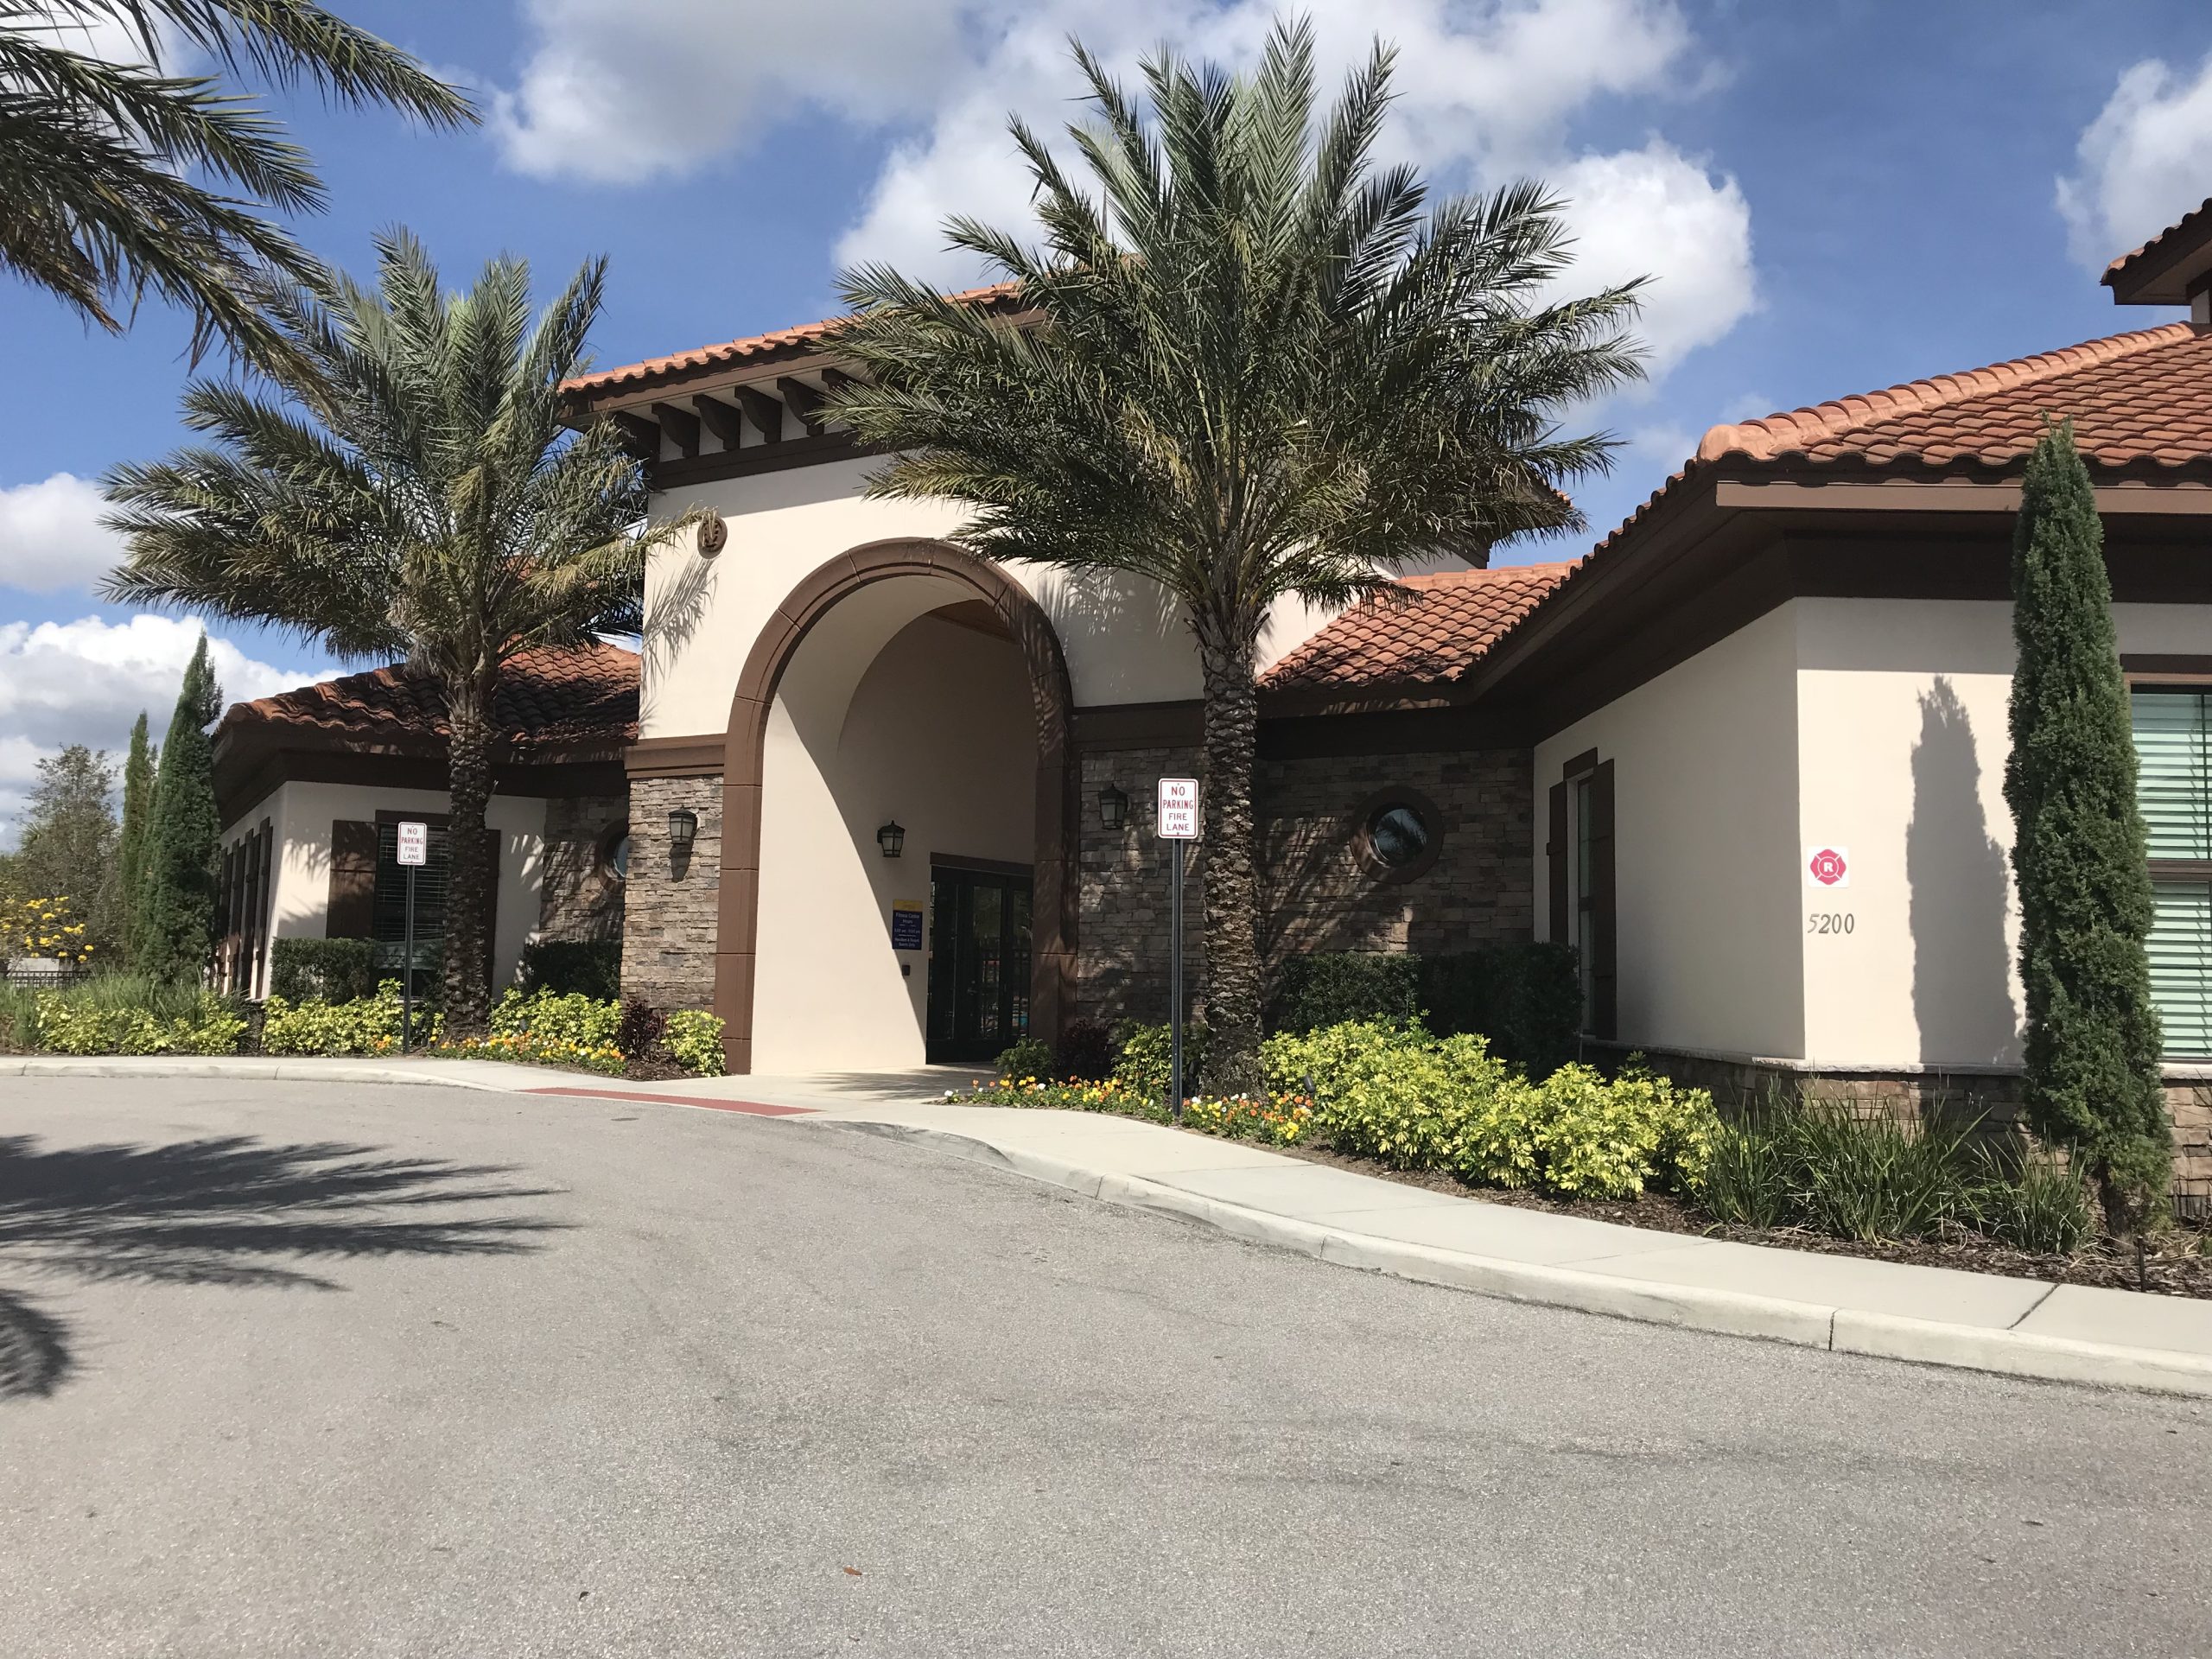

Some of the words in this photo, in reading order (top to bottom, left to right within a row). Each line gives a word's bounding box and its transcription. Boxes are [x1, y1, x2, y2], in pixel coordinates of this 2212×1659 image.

[1171, 785, 1185, 796] NO
[1162, 799, 1194, 810] PARKING
[1168, 812, 1188, 821] FIRE
[407, 827, 418, 836] NO
[401, 836, 423, 845] PARKING
[1823, 861, 1834, 873] R
[1807, 912, 1855, 935] 5200
